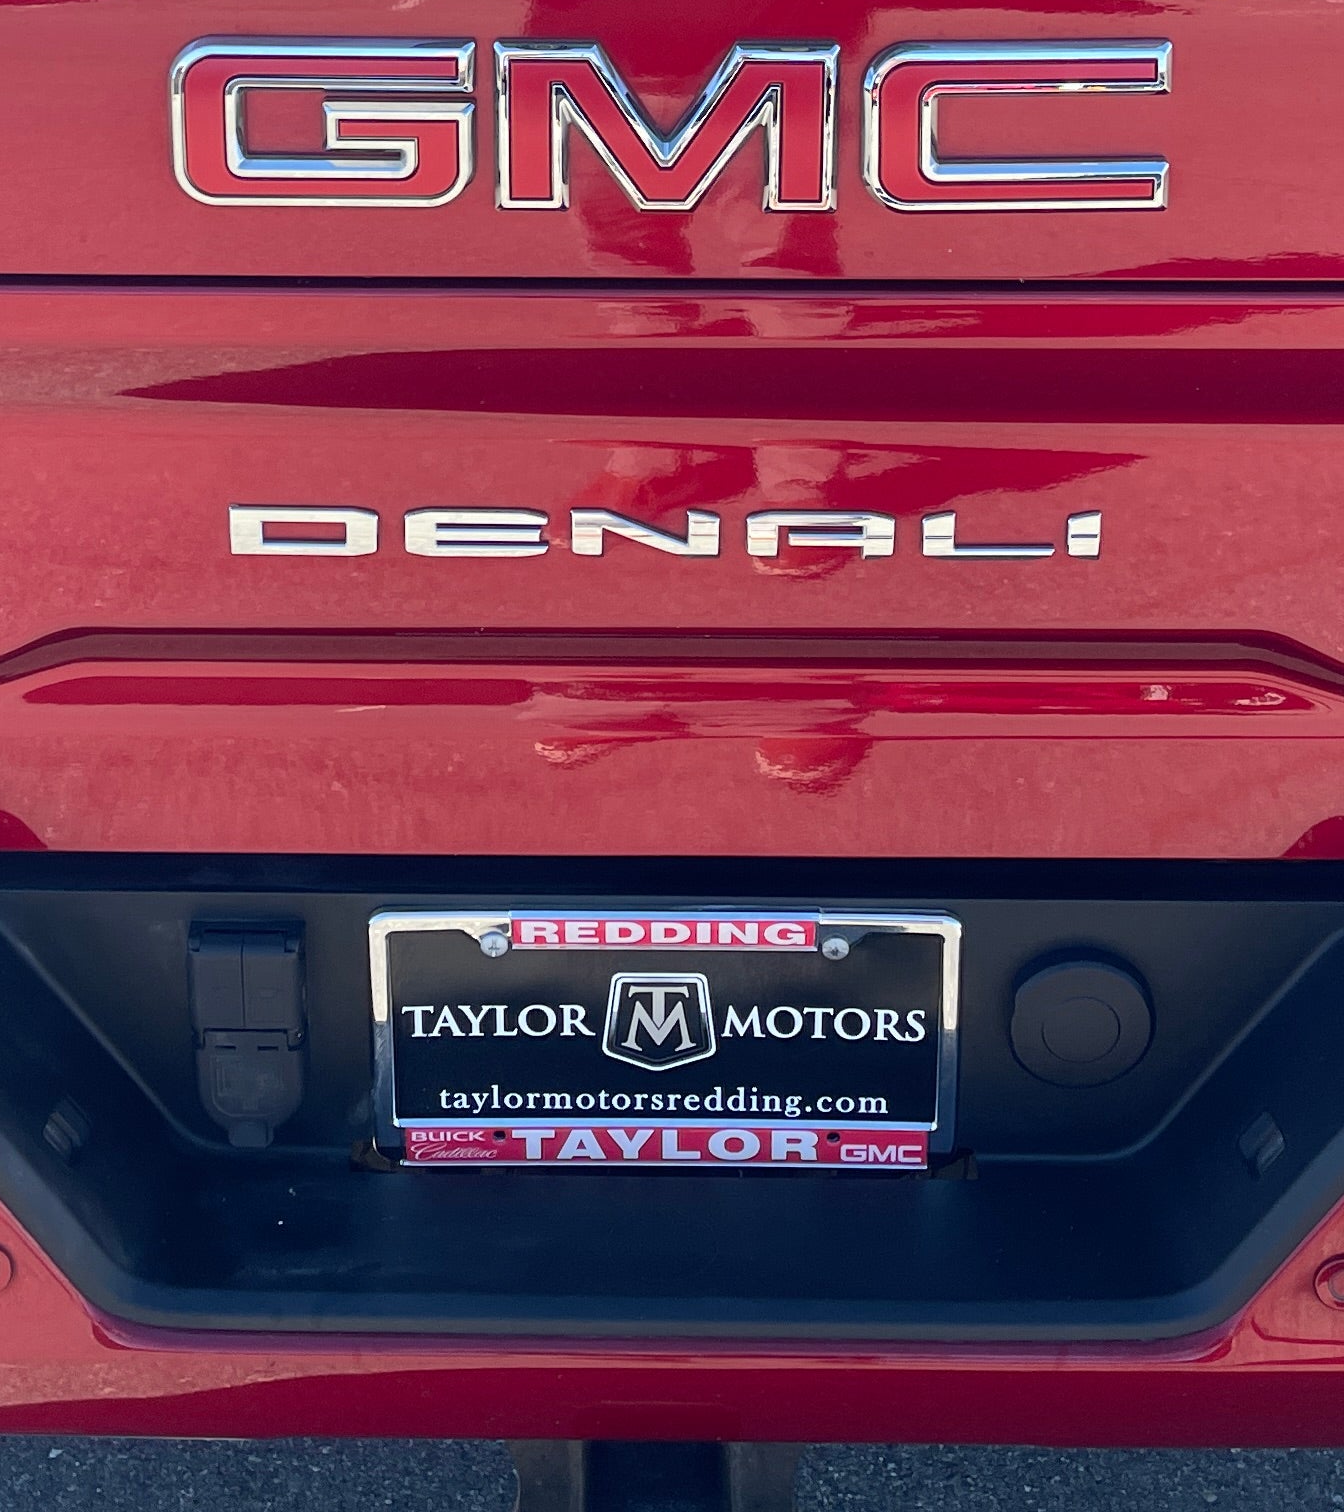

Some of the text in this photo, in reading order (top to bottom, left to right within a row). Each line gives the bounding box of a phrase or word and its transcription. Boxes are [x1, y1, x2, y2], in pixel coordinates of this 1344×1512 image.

[168, 35, 1175, 213] GMC
[228, 503, 1102, 560] DENALI
[520, 920, 807, 946] REDDING
[401, 1003, 596, 1038] TAYLOR
[720, 1004, 926, 1043] MOTORS
[439, 1084, 889, 1118] taylormotorsredding.com
[409, 1142, 498, 1161] Cadillac
[410, 1128, 923, 1164] BUICK TAYLOR GMC
